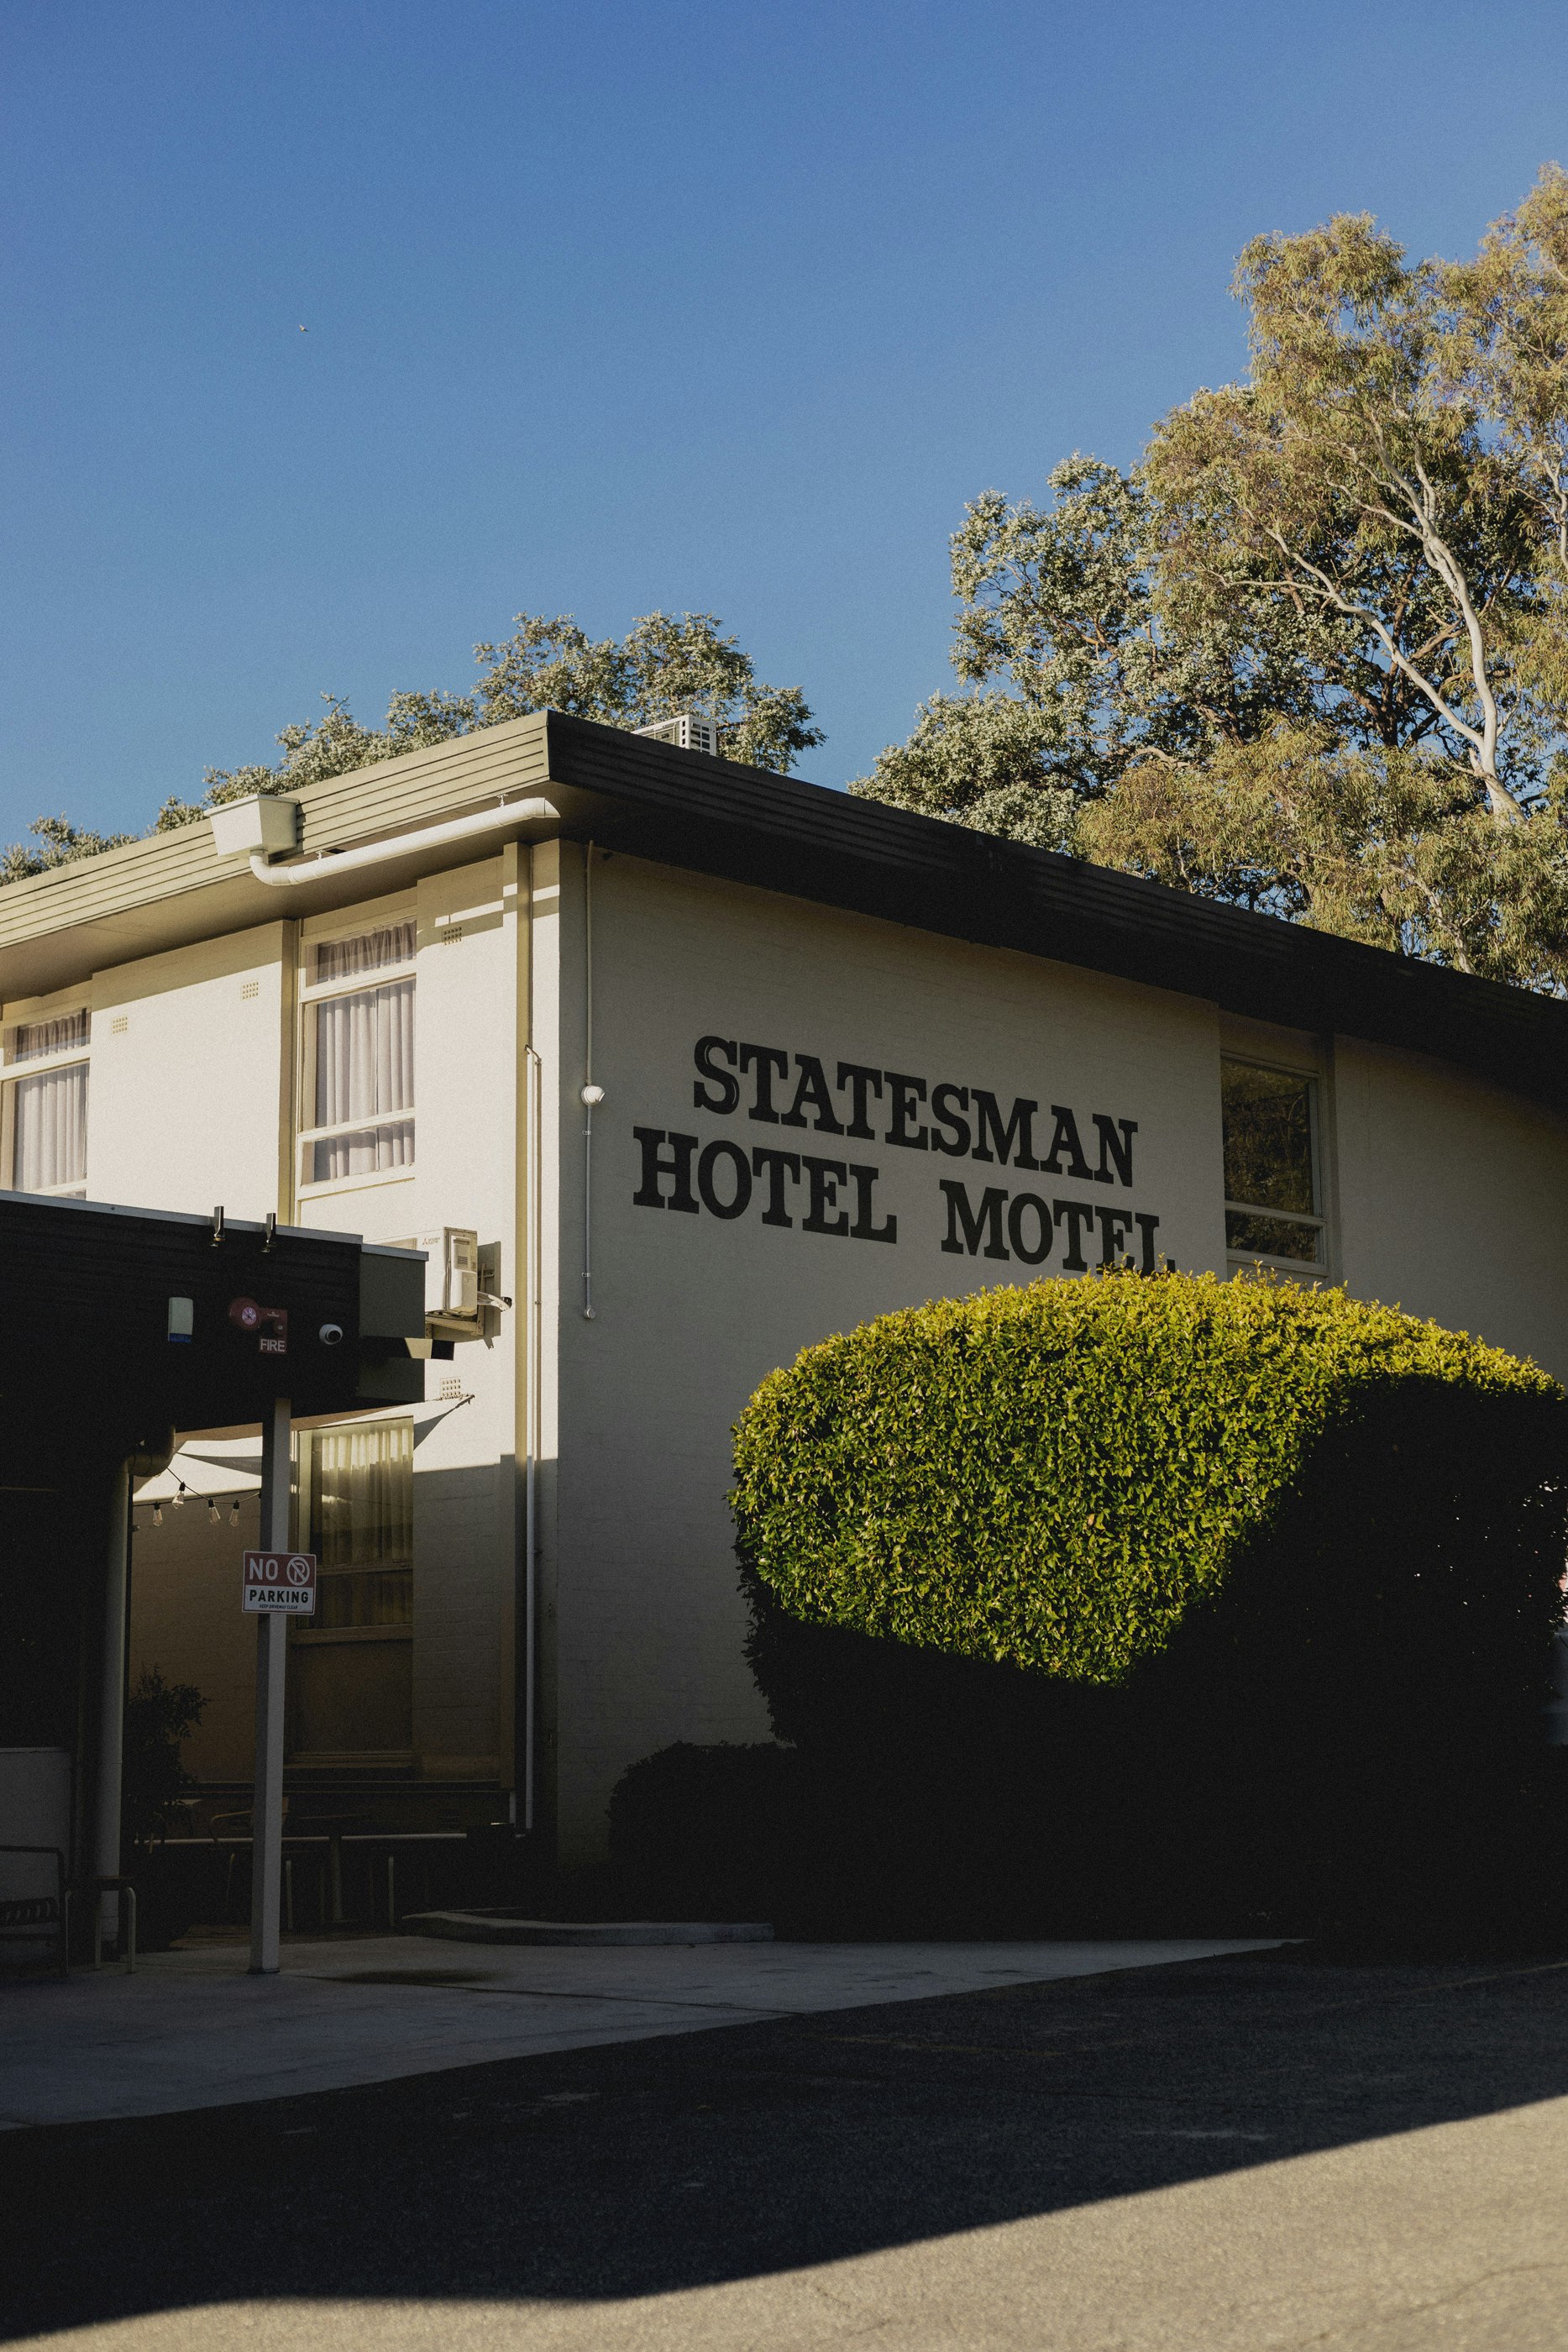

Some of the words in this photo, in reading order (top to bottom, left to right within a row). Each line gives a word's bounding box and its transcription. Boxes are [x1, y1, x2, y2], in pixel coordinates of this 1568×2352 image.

[694, 1035, 1138, 1188] STATESMAN
[633, 1126, 897, 1244] HOTEL
[939, 1179, 1176, 1280] MOTEL
[260, 1339, 286, 1352] FIRE
[249, 1558, 278, 1580] NO
[249, 1589, 308, 1603] PARKING
